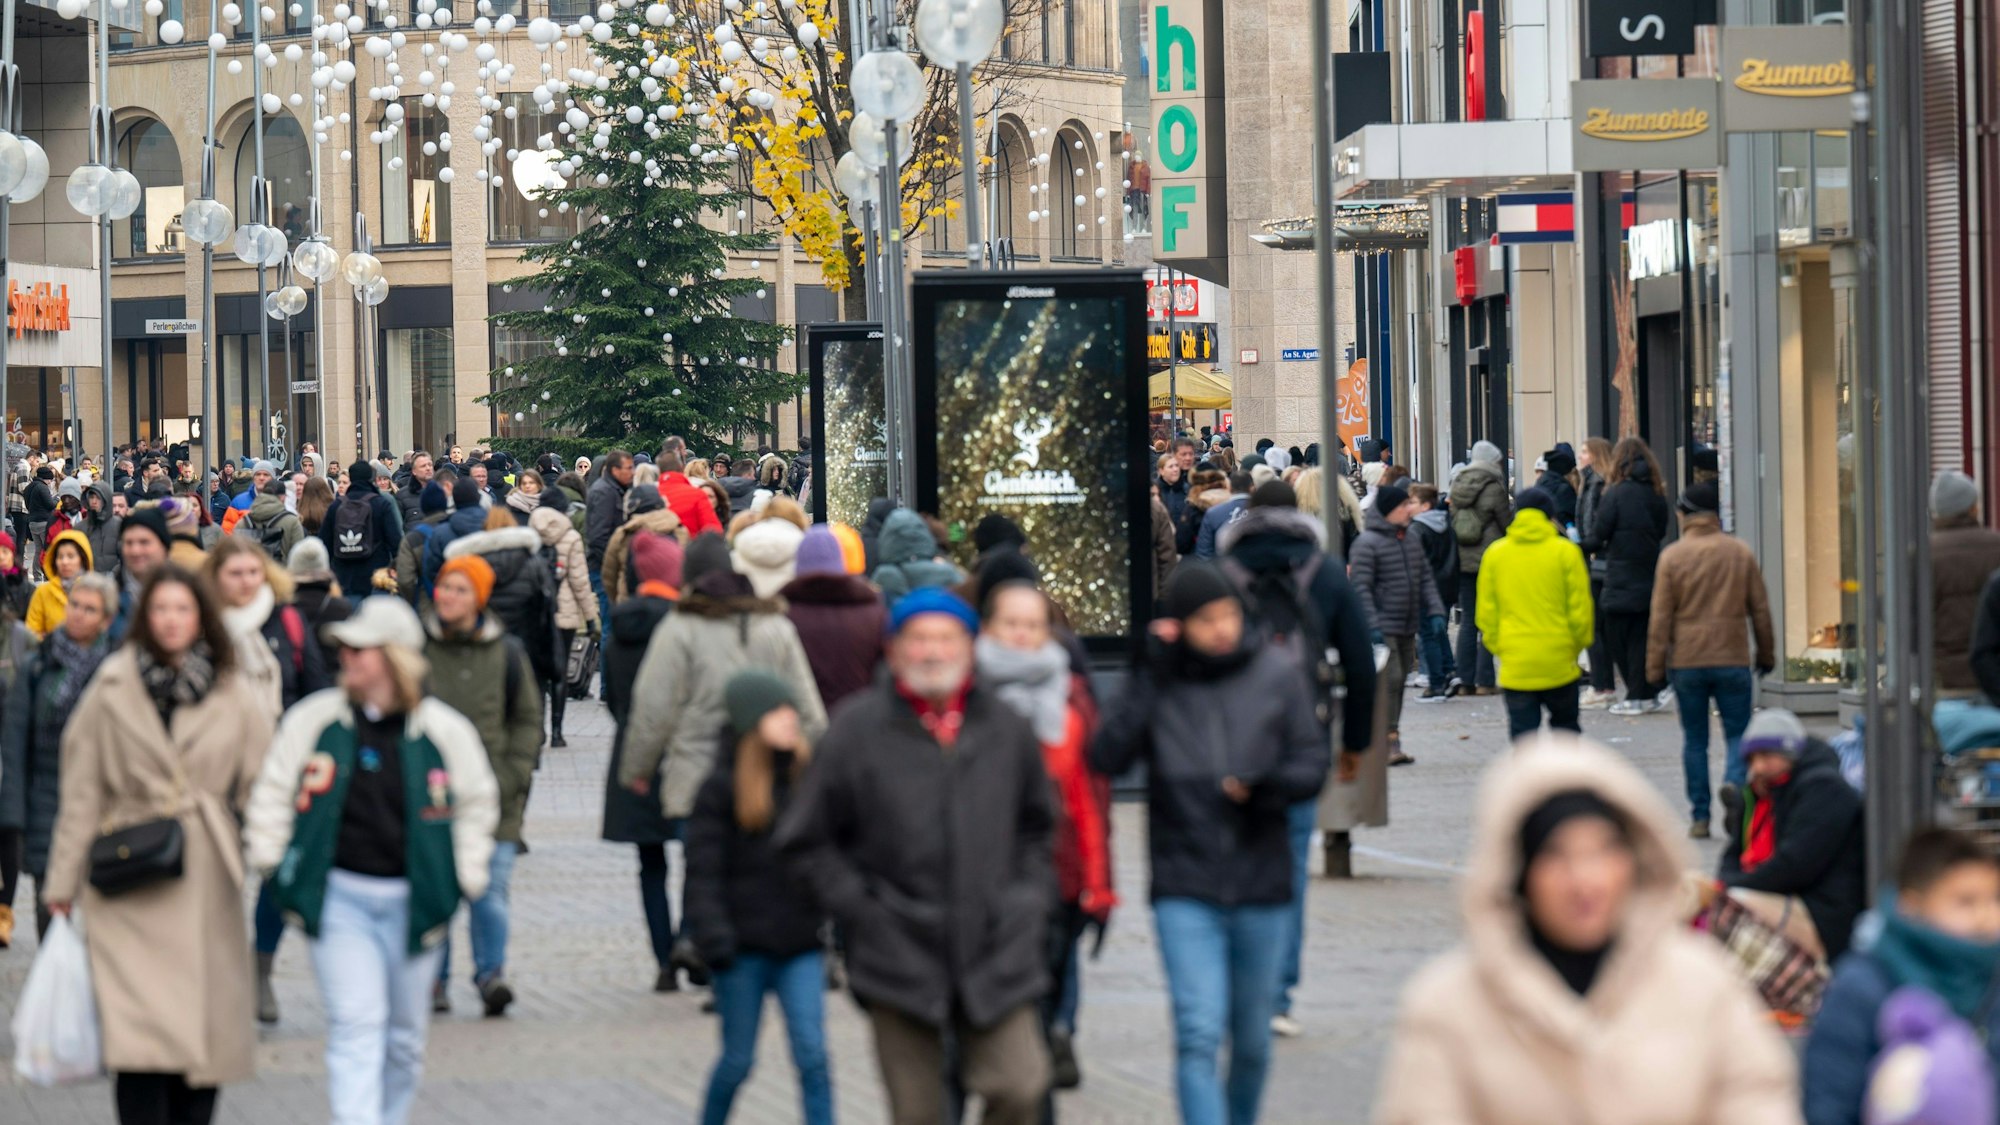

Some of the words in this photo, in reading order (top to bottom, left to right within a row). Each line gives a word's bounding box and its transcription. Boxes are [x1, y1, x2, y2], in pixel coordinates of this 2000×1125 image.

[1734, 58, 1875, 97] Zumnor
[1581, 107, 1709, 141] Zumnorde
[1302, 350, 1320, 359] Agath
[340, 545, 363, 553] adidas
[295, 753, 337, 814] P
